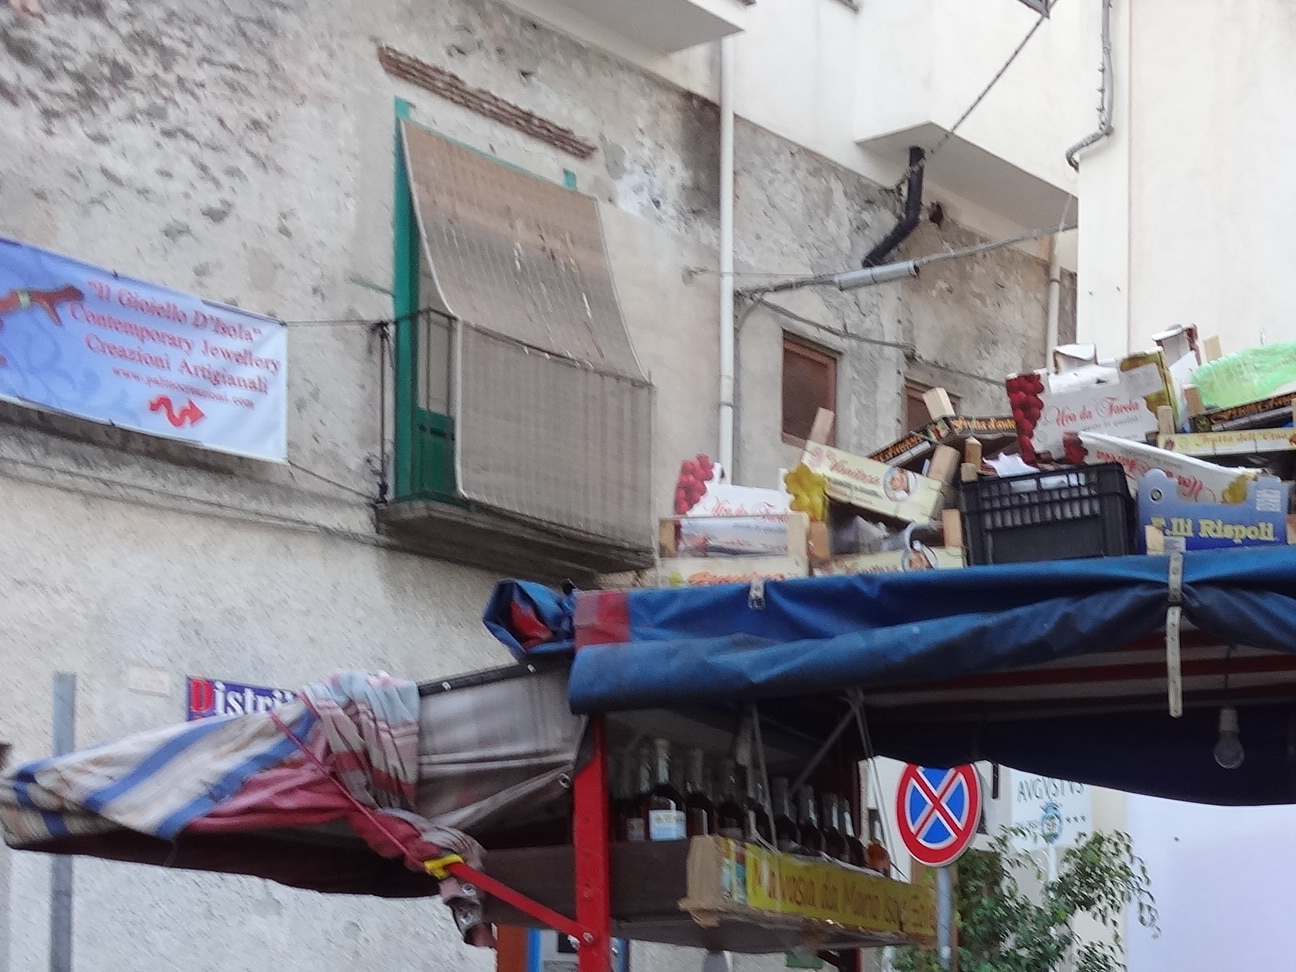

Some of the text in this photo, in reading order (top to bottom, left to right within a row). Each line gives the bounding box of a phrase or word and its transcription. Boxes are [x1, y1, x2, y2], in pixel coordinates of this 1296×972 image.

[69, 302, 281, 375] Contemporary Jewellery
[85, 332, 171, 371] Creazioni
[180, 353, 269, 395] Artigianali
[1080, 405, 1093, 421] da
[1199, 518, 1275, 543] Rispoli
[189, 677, 298, 717] Distri
